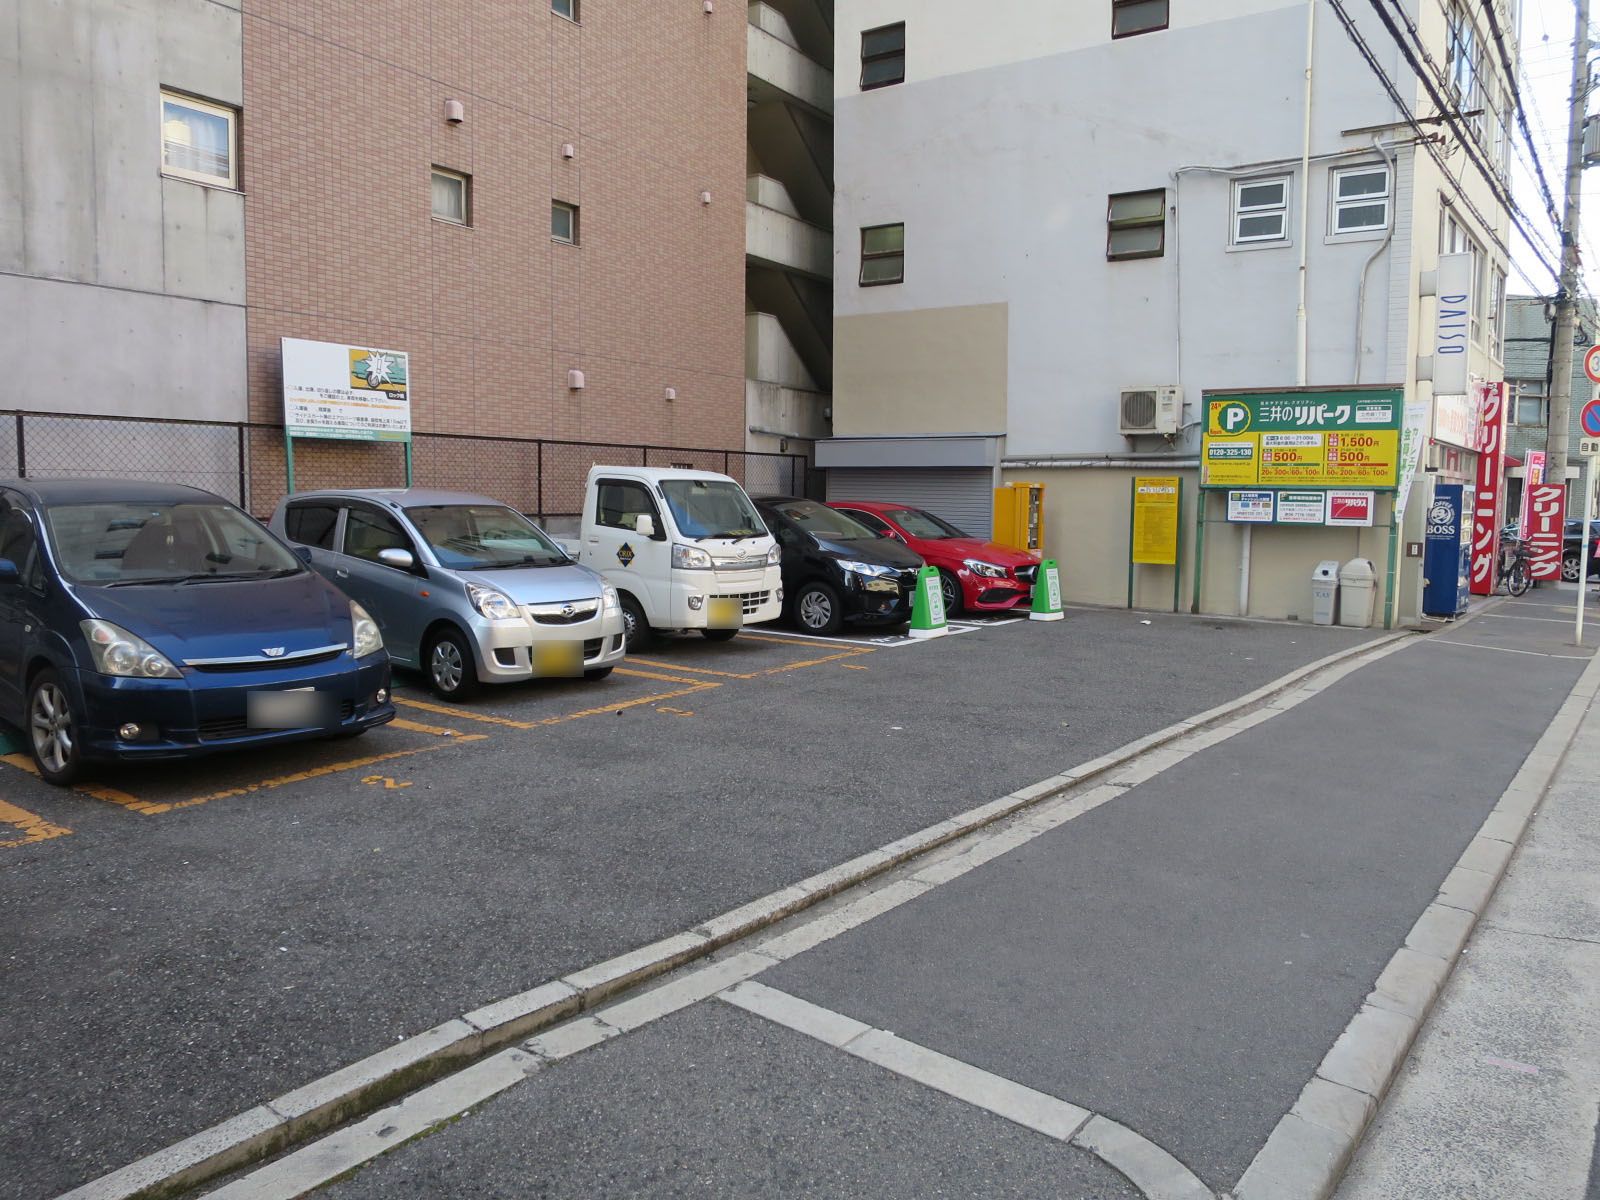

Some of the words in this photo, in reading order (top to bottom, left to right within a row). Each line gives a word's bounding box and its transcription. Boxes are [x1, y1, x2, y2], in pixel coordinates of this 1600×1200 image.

[1226, 407, 1245, 430] P
[1259, 403, 1351, 426] 三井のリパーク
[1340, 436, 1380, 447] 1,500円
[1274, 452, 1303, 462] 500円
[1340, 452, 1370, 462] 500円
[1472, 396, 1500, 583] クリーニング
[1427, 526, 1455, 535] BOSS
[1531, 487, 1562, 576] クリーニング
